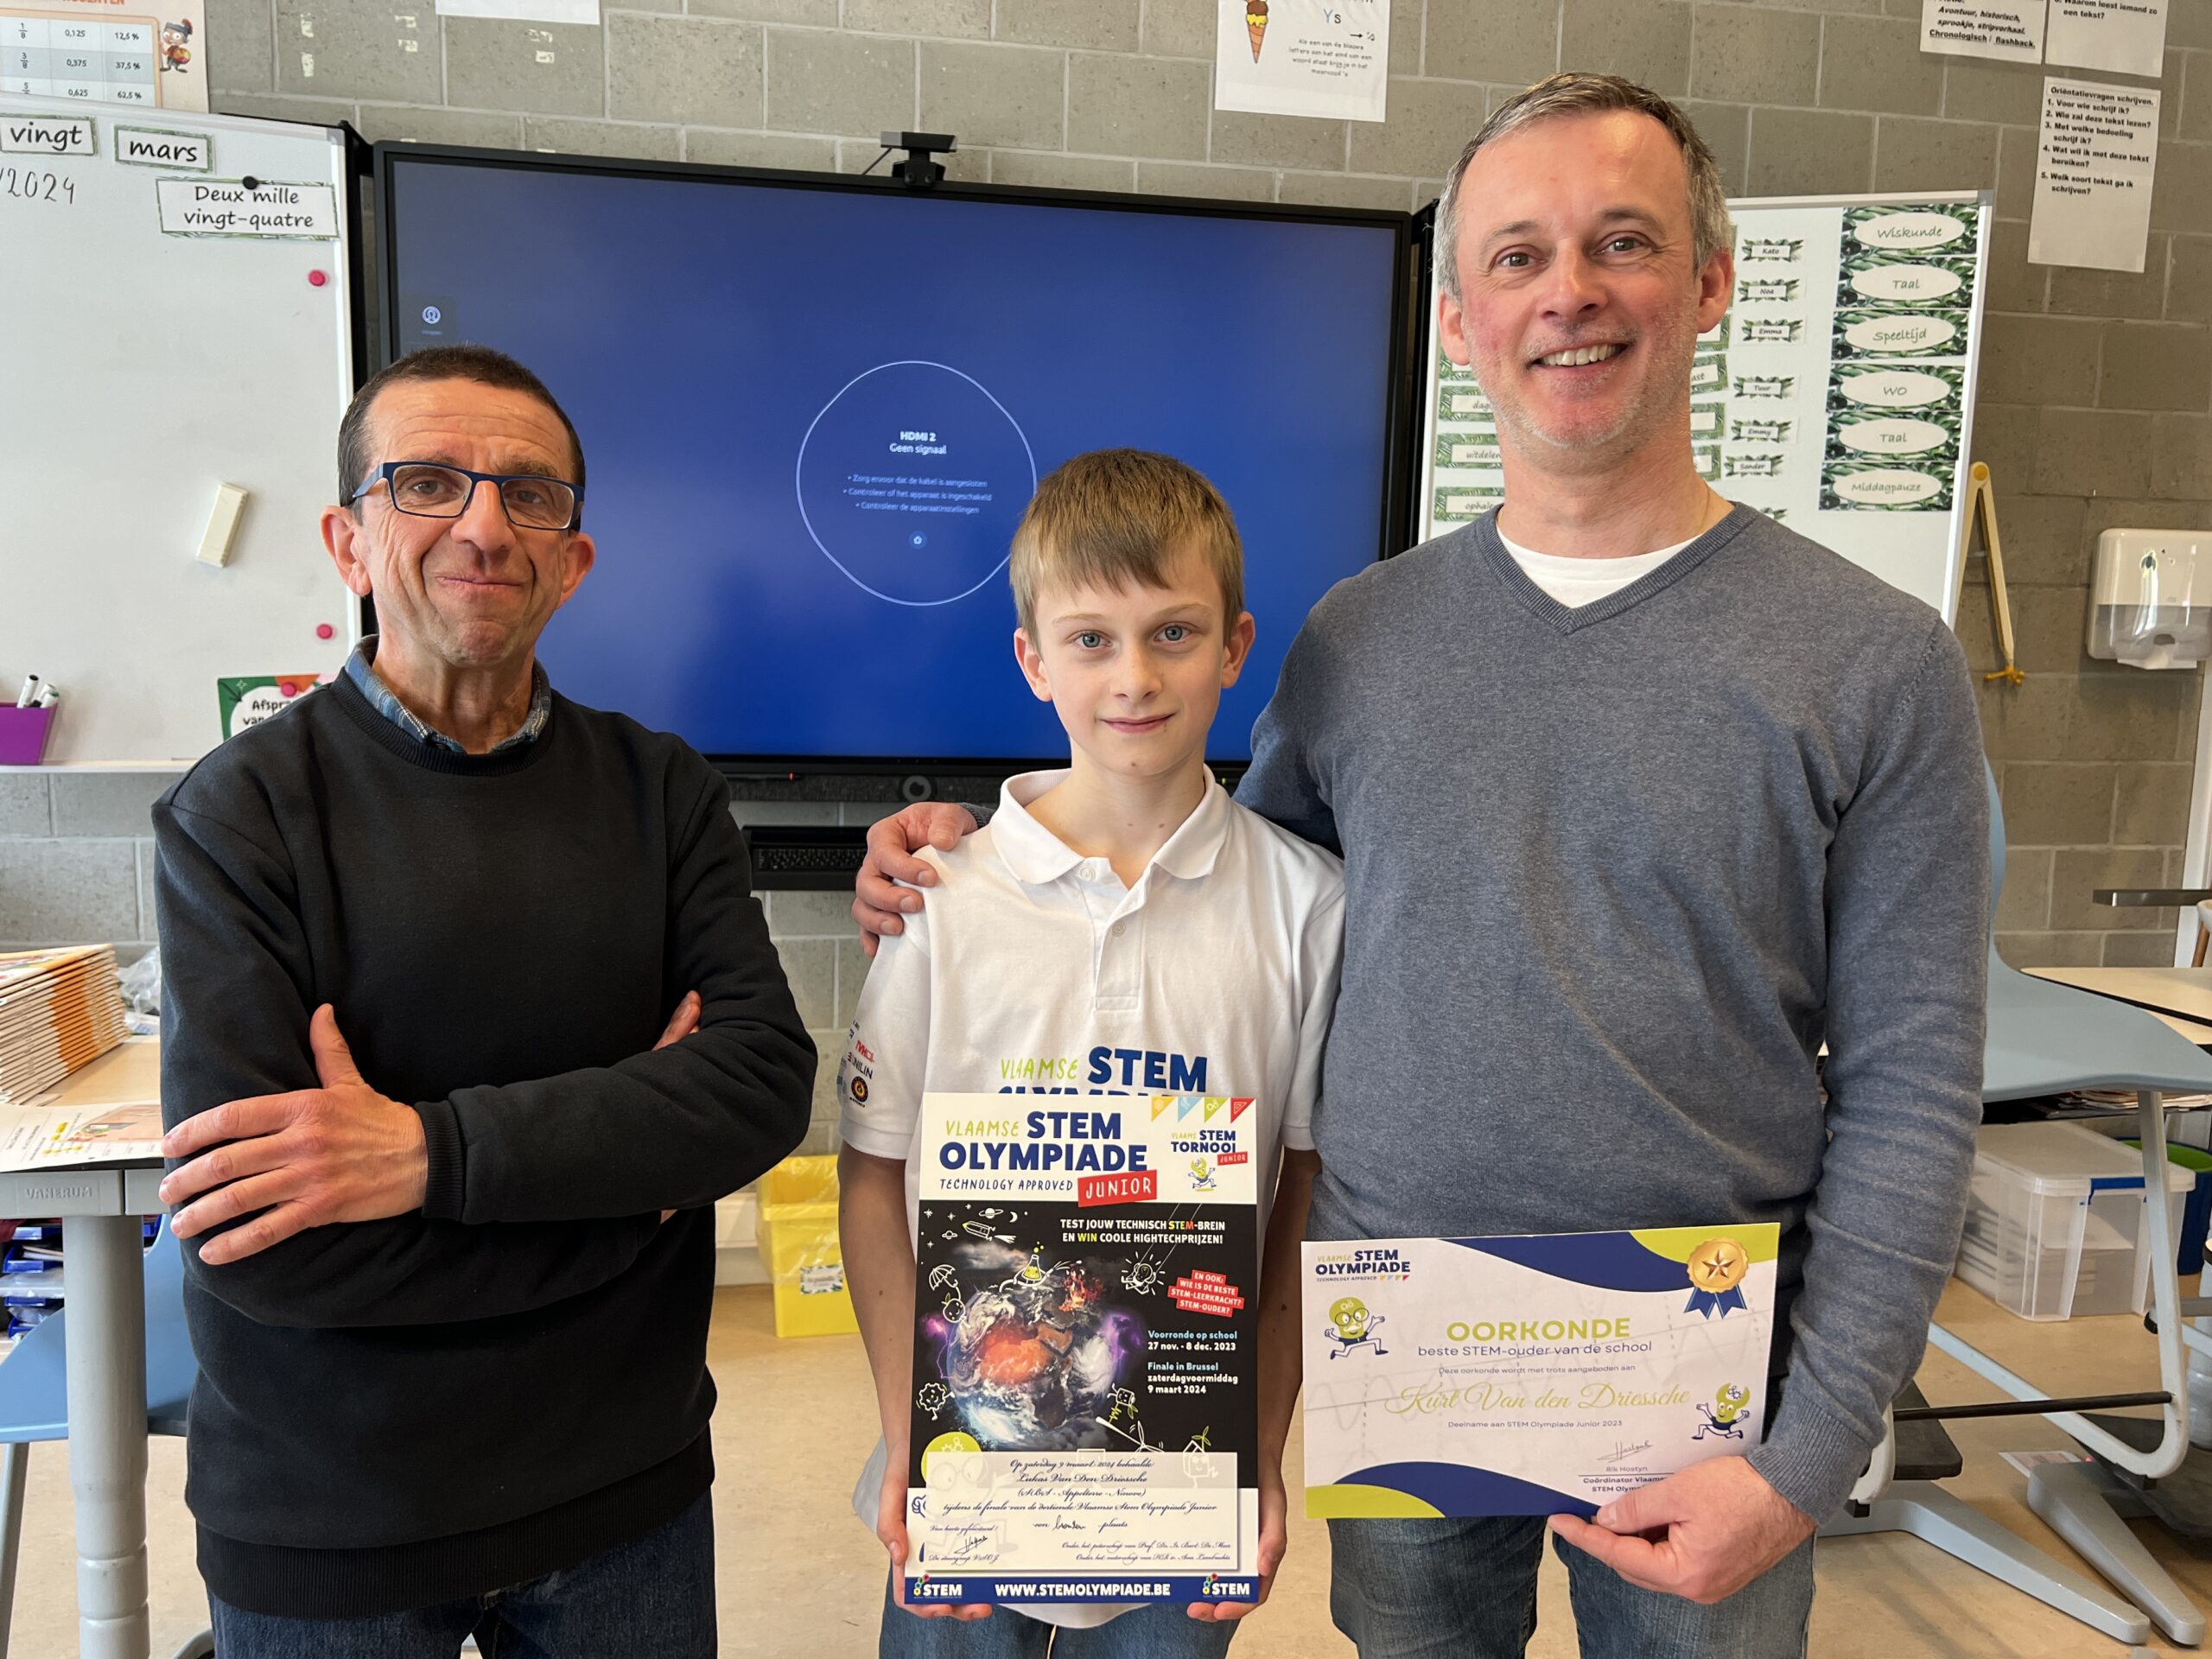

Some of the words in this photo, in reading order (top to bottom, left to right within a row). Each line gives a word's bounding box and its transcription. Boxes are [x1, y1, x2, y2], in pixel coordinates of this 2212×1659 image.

[65, 29, 86, 37] 0,125
[67, 59, 86, 67] 0,375
[2093, 103, 2116, 114] schrijf
[2071, 124, 2094, 133] welke
[2126, 119, 2151, 128] lezen?
[10, 121, 82, 151] vingt
[2053, 135, 2078, 144] schrijf
[130, 140, 197, 162] mars
[2052, 145, 2068, 154] Wat
[2129, 154, 2149, 162] tekst
[2051, 156, 2089, 168] bereiken?
[2050, 173, 2069, 181] Welk
[194, 186, 244, 202] Deux
[252, 188, 299, 204] mille
[2051, 185, 2091, 195] schrijven?
[184, 208, 314, 230] vingt-quatre
[1877, 226, 1942, 238] Wiskunde
[1892, 279, 1920, 289] Taal
[1872, 327, 1927, 344] Speeltijd
[1883, 386, 1908, 396] WO
[899, 431, 928, 442] HDMI
[929, 432, 937, 442] 2
[1880, 433, 1908, 442] Taal
[889, 443, 914, 453] Geen
[915, 444, 947, 455] signaal
[1851, 482, 1922, 494] Middagpauze
[1465, 501, 1495, 515] ophale
[252, 698, 291, 714] Afspr
[1001, 1057, 1078, 1079] VLAAMSE
[1087, 1046, 1208, 1093] STEM
[945, 1119, 1020, 1137] VLAAMSE
[1027, 1110, 1122, 1140] STEM
[1199, 1129, 1236, 1141] STEM
[1170, 1141, 1236, 1154] TORNOOI
[939, 1141, 1147, 1172] OLYMPIADE
[1220, 1154, 1246, 1164] JUNIOR
[940, 1179, 1014, 1191] TECHNOLOGY
[1018, 1179, 1073, 1192] APPROVED
[1085, 1177, 1152, 1200] JUNIOR
[27, 1186, 92, 1199] VANERUM
[1060, 1218, 1084, 1229] TEST
[1086, 1219, 1114, 1230] JOUW
[1116, 1219, 1166, 1230] TECHNISCH
[1168, 1220, 1225, 1230] STEM-BREIN
[1062, 1232, 1075, 1243] EN
[1077, 1232, 1097, 1243] WIN
[1099, 1233, 1131, 1243] COOLE
[1134, 1233, 1223, 1245] HIGHTECHPRIJZEN!
[1355, 1249, 1398, 1262] STEM
[1315, 1262, 1410, 1274] OLYMPIADE
[1179, 1280, 1192, 1288] WIE
[1203, 1283, 1213, 1292] DE
[1213, 1286, 1236, 1295] BESTE
[1171, 1288, 1242, 1306] STEM-LEERKRACHT?
[1179, 1300, 1230, 1313] STEM-OUDER?
[1196, 1332, 1208, 1341] op
[1209, 1331, 1237, 1339] school
[1446, 1318, 1630, 1342] OORKONDE
[1147, 1342, 1159, 1351] 27
[1185, 1342, 1192, 1351] 8
[1193, 1341, 1212, 1351] dec.
[1214, 1342, 1236, 1351] 2023
[1418, 1345, 1459, 1357] beste
[1463, 1344, 1549, 1357] STEM-ouder
[1554, 1344, 1580, 1354] van
[1583, 1343, 1601, 1354] de
[1605, 1341, 1652, 1353] school
[1147, 1362, 1174, 1370] Finale
[1176, 1362, 1185, 1370] in
[1185, 1362, 1218, 1370] Brussel
[1567, 1365, 1619, 1375] aangeboden
[1147, 1373, 1238, 1385] zaterdagvoormiddag
[1147, 1385, 1154, 1394] 9
[1155, 1385, 1182, 1394] maart
[1184, 1385, 1206, 1394] 2024
[1384, 1383, 1460, 1414] Kurt
[1464, 1382, 1525, 1410] Van
[1535, 1388, 1570, 1408] den
[1578, 1382, 1690, 1408] Driessche
[1530, 1421, 1574, 1429] Olympiade
[1010, 1459, 1023, 1472] Op
[1050, 1472, 1071, 1483] Van
[1074, 1473, 1098, 1483] Den
[923, 1583, 963, 1596] STEM
[995, 1582, 1172, 1597] WWW.STEMOLYMPIADE.BE
[1211, 1582, 1250, 1595] STEM
